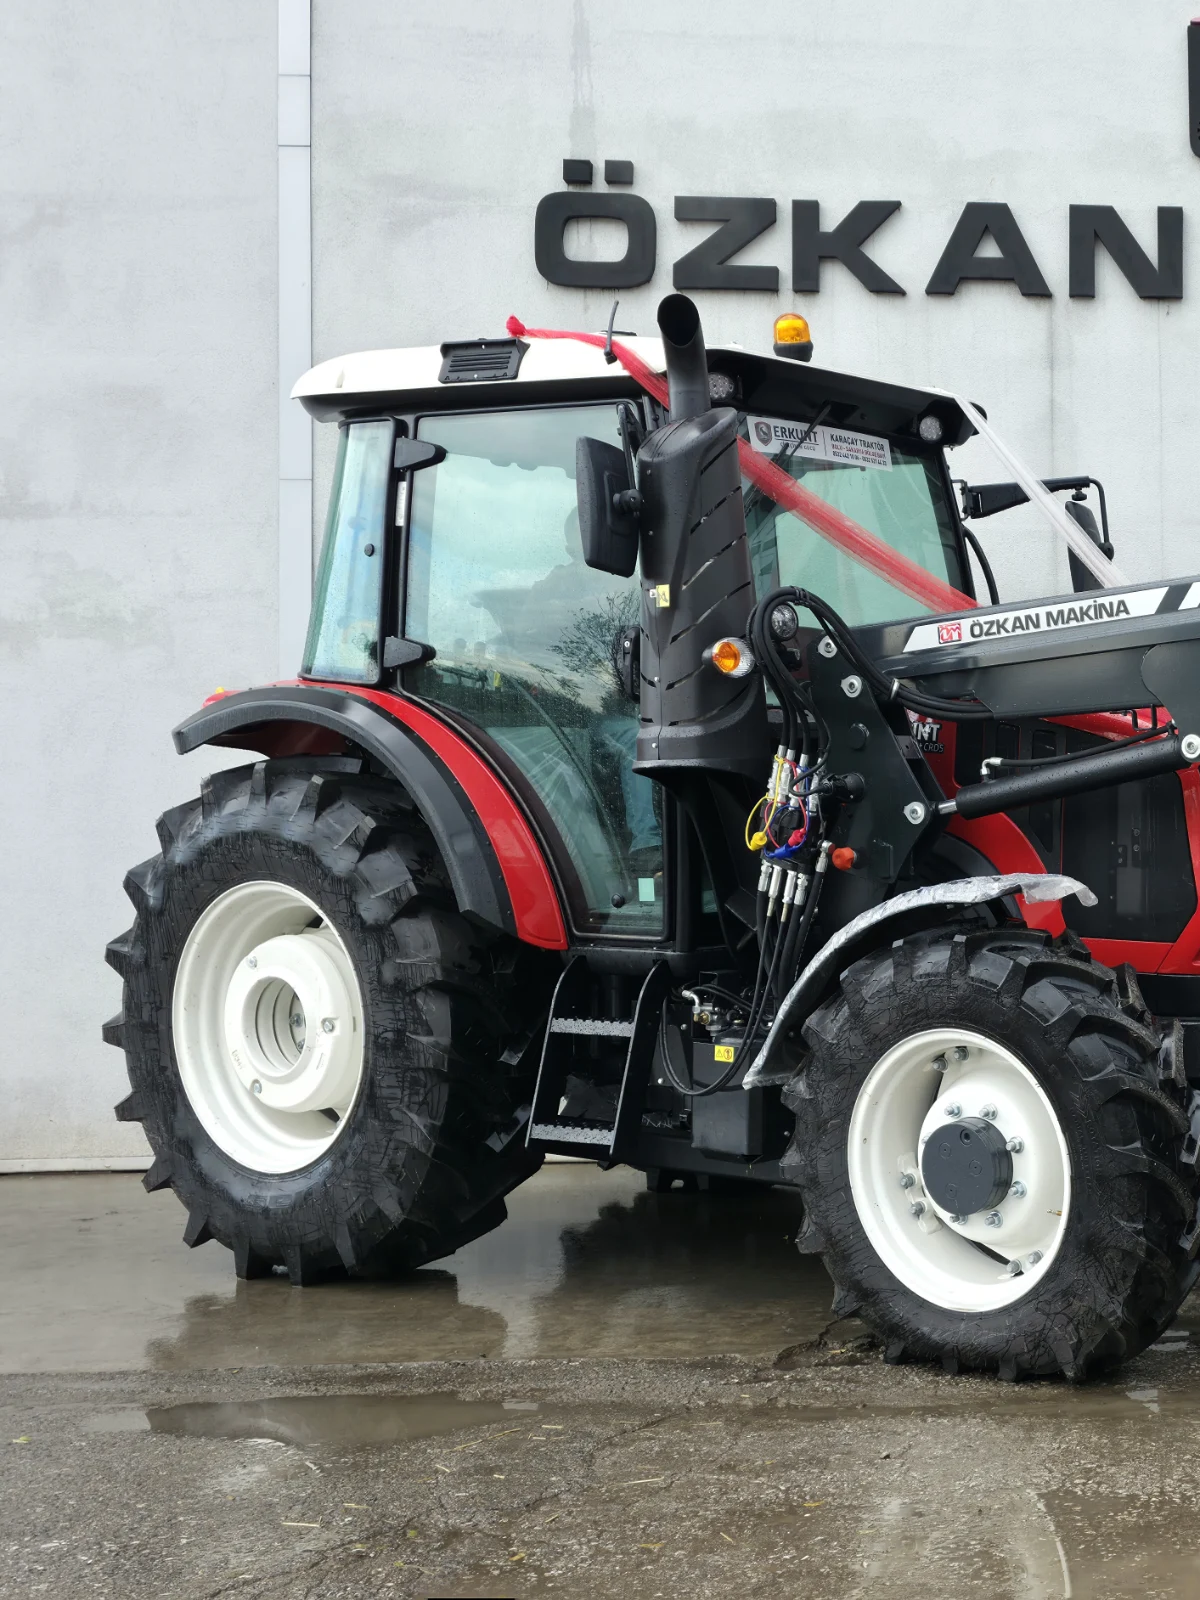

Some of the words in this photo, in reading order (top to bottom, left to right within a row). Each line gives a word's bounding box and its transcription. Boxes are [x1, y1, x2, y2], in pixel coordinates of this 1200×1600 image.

[534, 158, 1184, 299] ÖZKAN
[773, 425, 818, 442] ERKUNT
[969, 612, 1041, 639] ÖZKAN
[1046, 599, 1130, 628] MAKİNA
